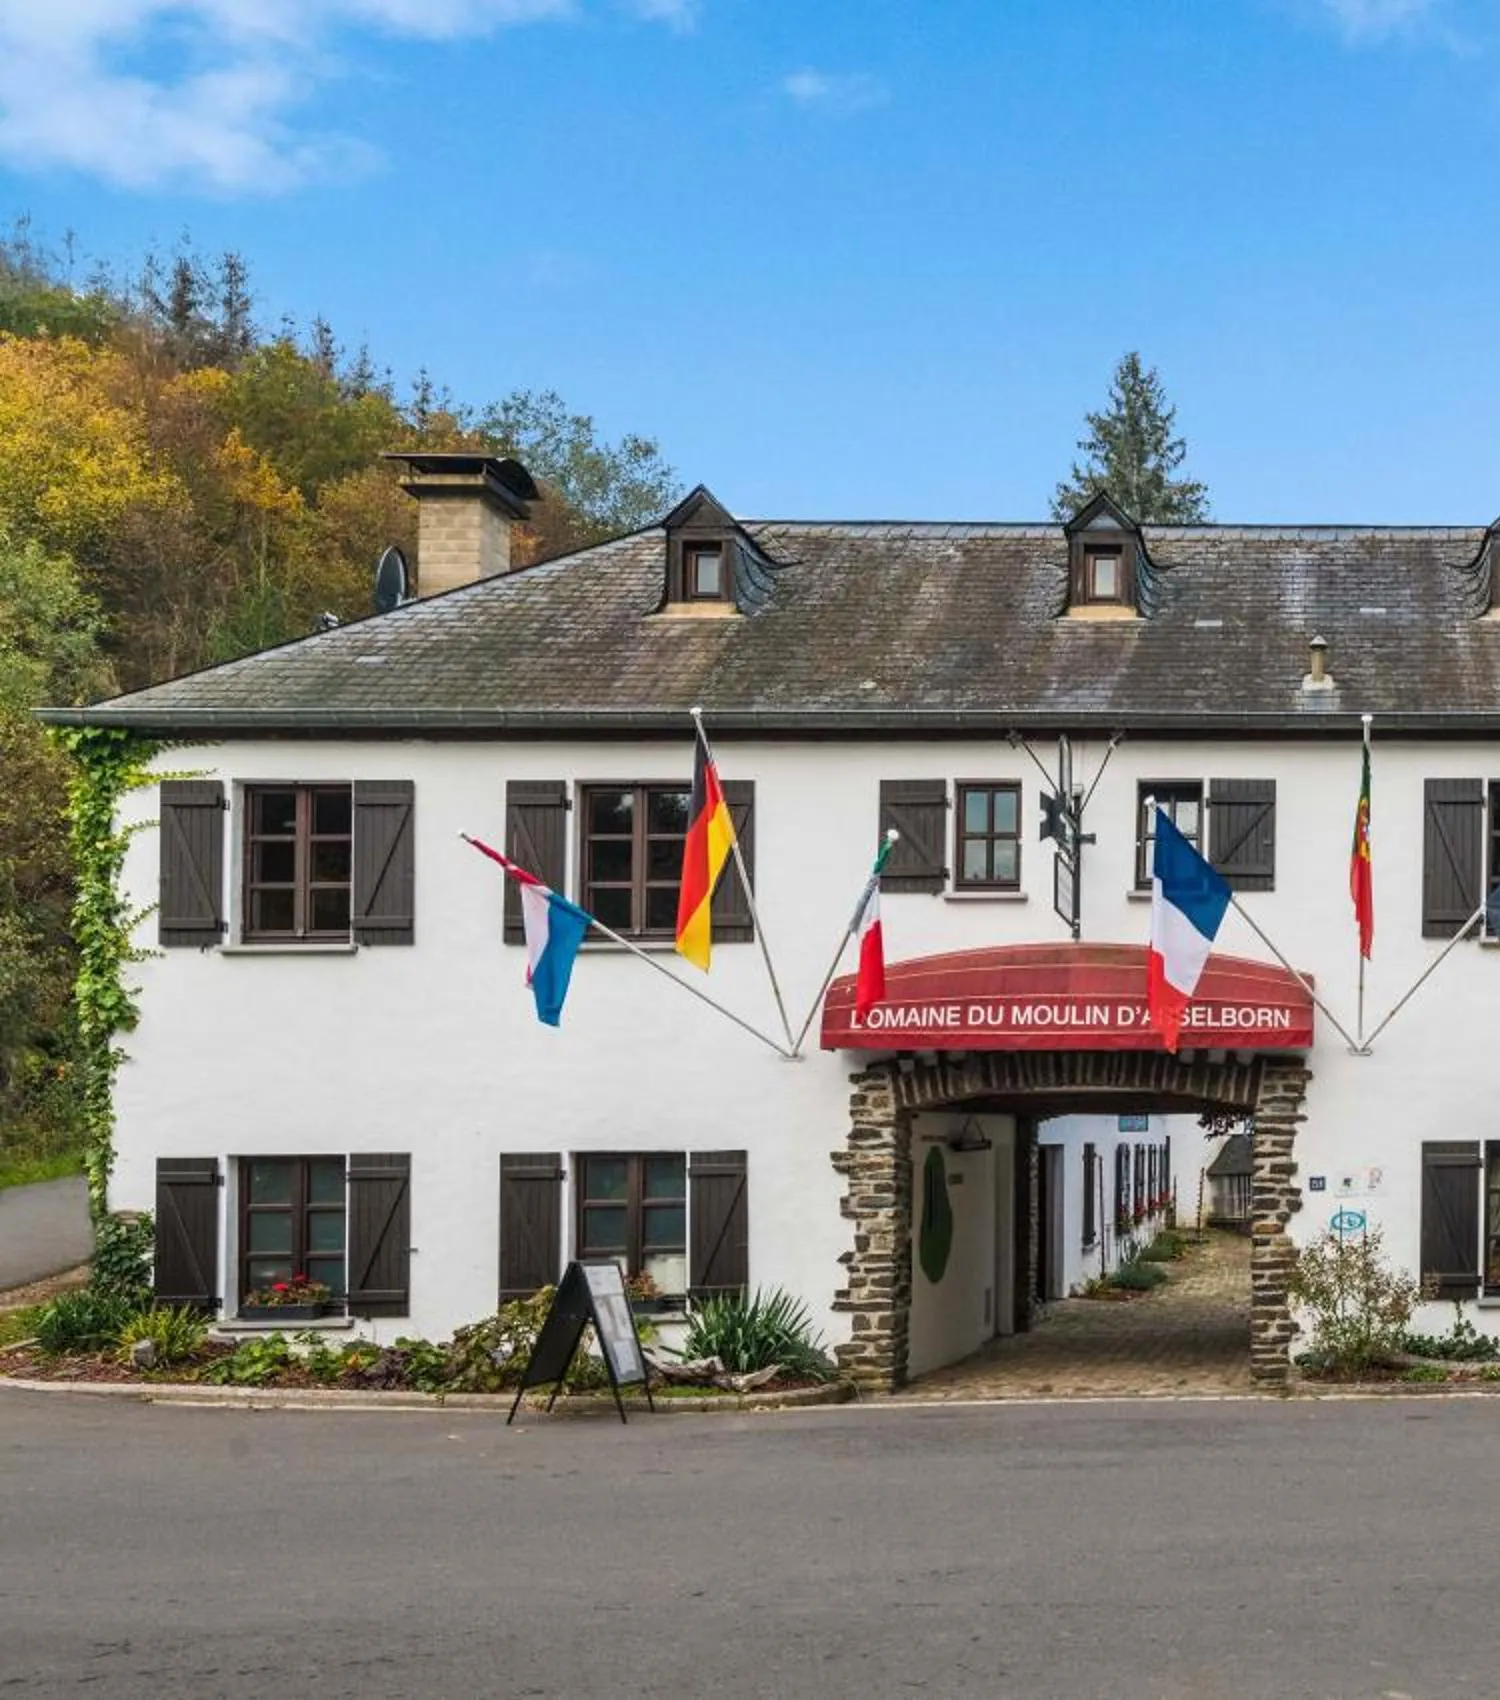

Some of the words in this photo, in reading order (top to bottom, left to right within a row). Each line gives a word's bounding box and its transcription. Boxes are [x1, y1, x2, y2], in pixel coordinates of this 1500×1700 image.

[967, 1005, 1005, 1025] DU
[1011, 1005, 1110, 1026] MOULIN
[1116, 1006, 1290, 1028] D'SELBORN
